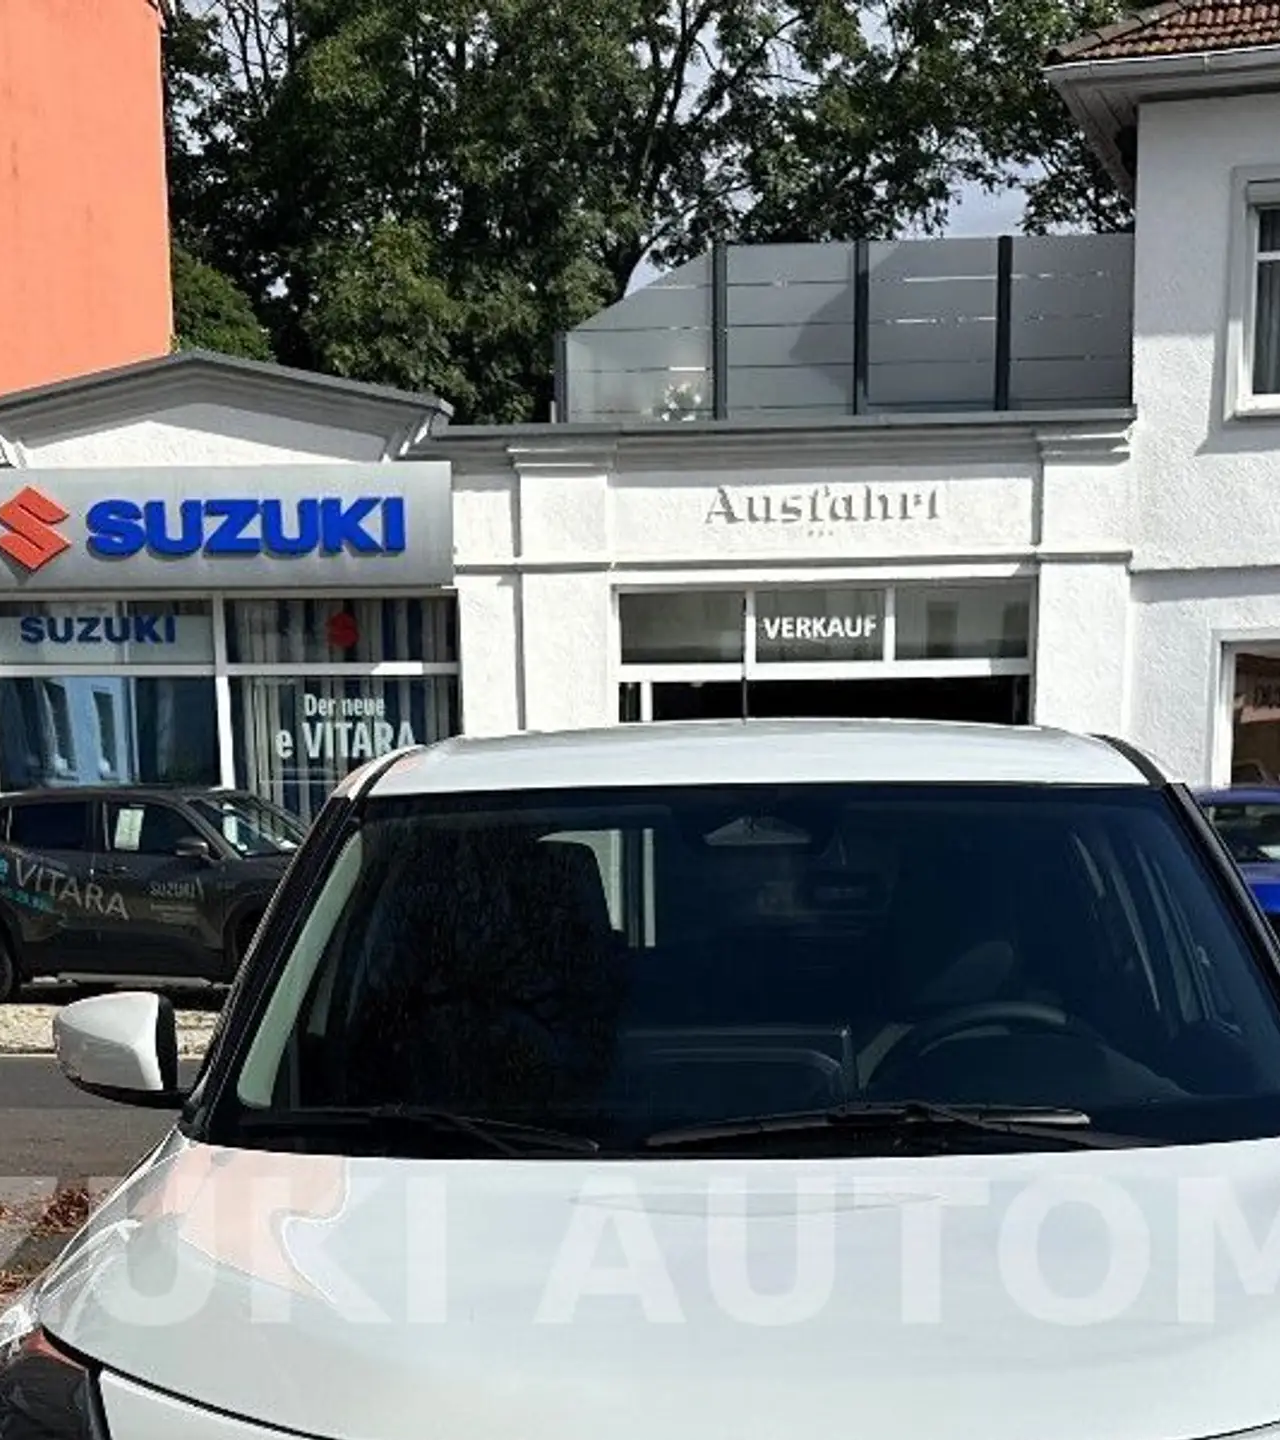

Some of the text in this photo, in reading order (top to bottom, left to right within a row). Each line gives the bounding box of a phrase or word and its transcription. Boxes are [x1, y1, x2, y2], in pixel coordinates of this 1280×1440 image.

[85, 496, 406, 560] SUZUKI
[20, 615, 176, 644] SUZUKI
[762, 615, 877, 640] VERKAUF
[303, 692, 386, 717] Der neue
[275, 721, 416, 759] e VITARA
[15, 857, 129, 921] VITARA
